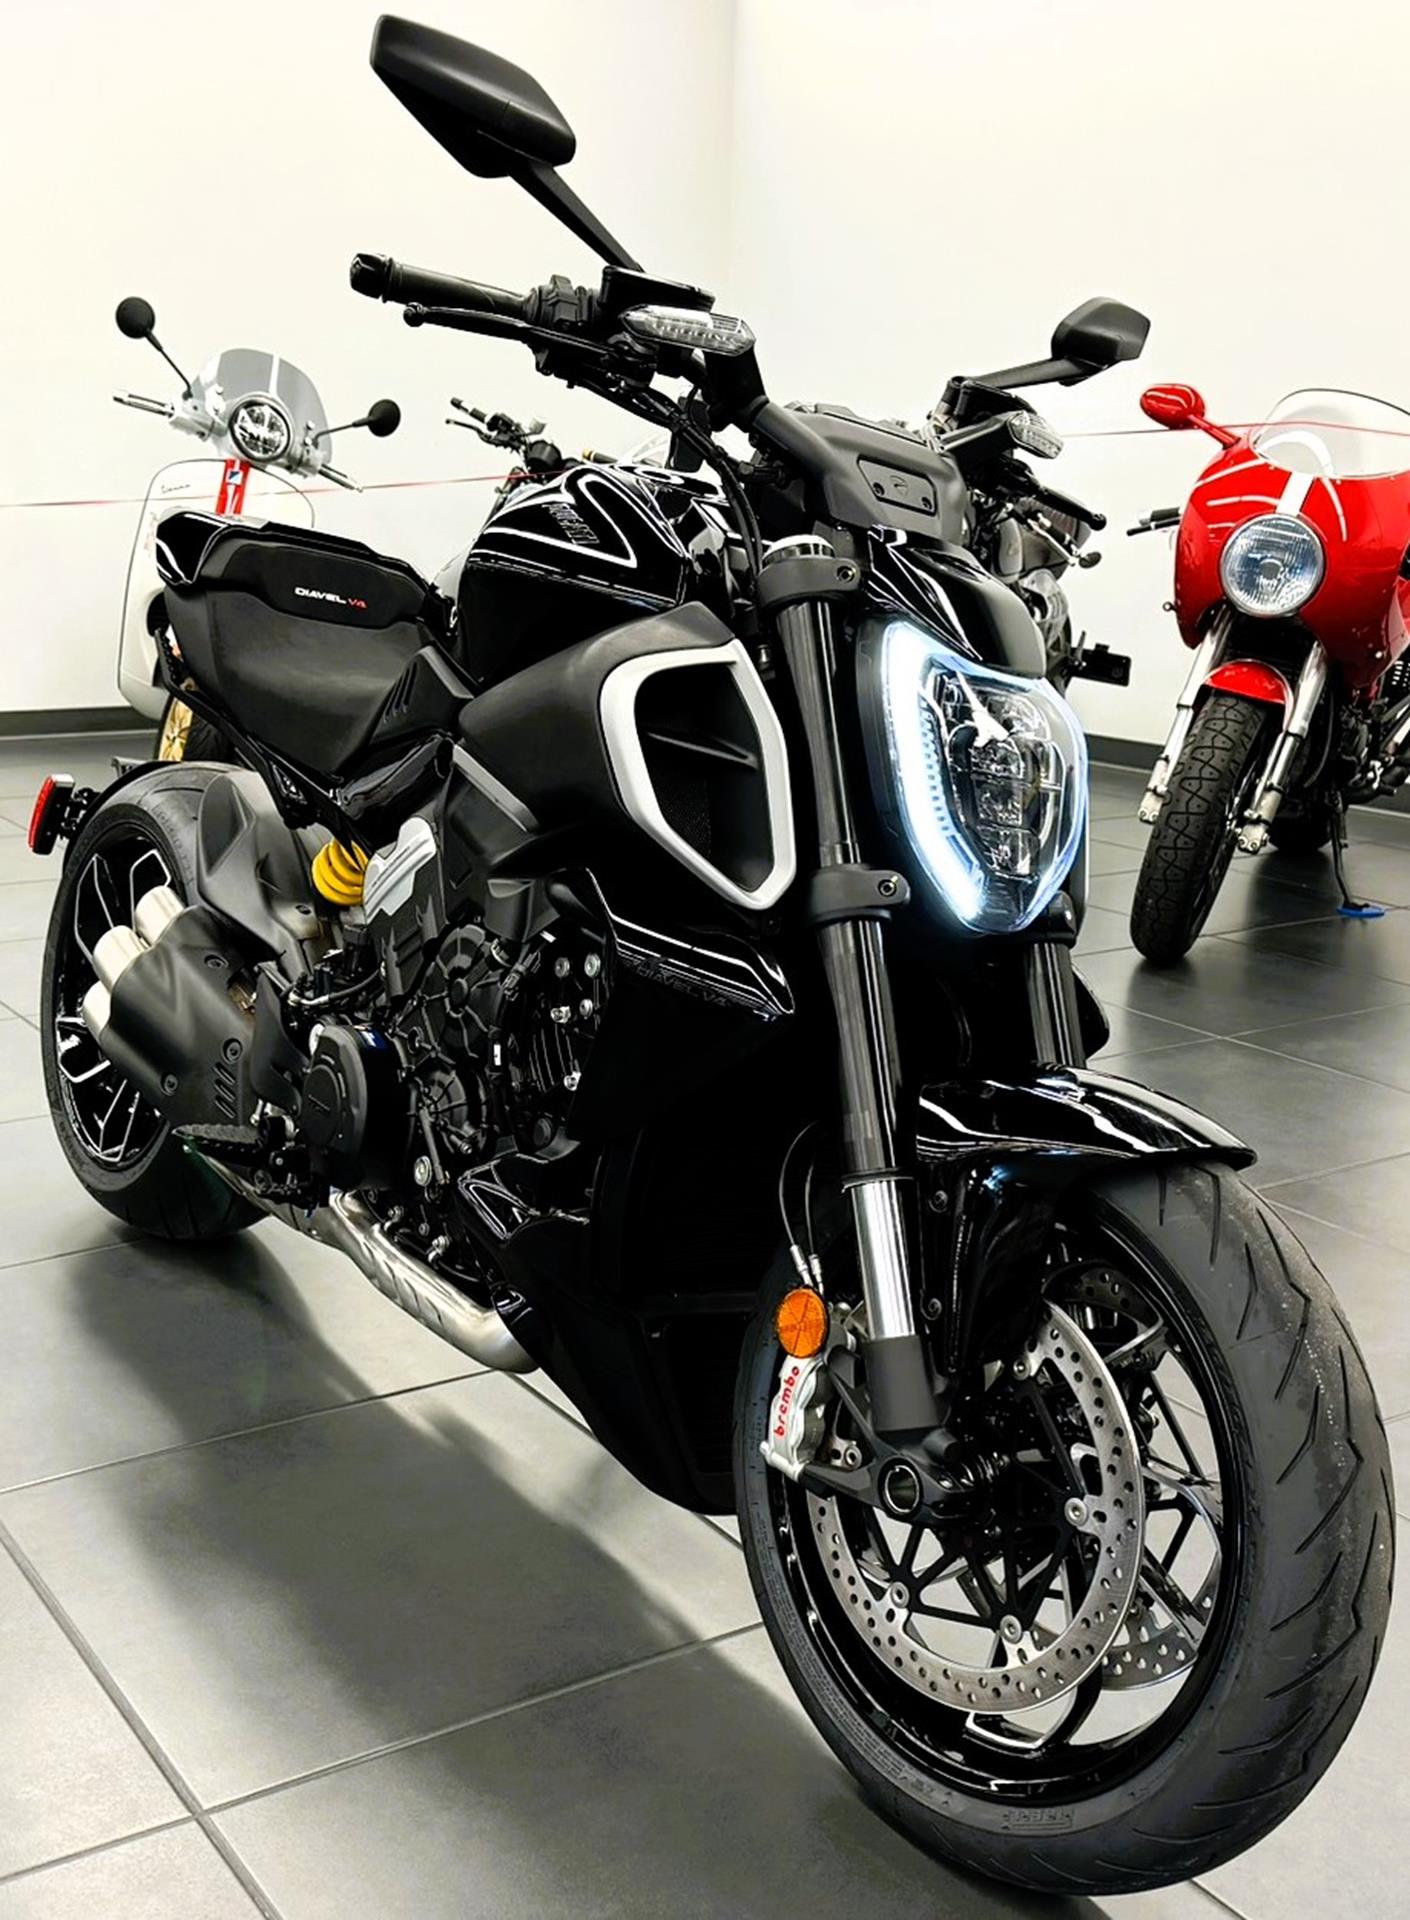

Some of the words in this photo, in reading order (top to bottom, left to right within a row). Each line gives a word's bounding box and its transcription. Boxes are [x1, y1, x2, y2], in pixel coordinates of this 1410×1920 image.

[294, 586, 347, 605] DIAVEL
[347, 598, 368, 609] V4
[773, 1365, 800, 1436] brembo
